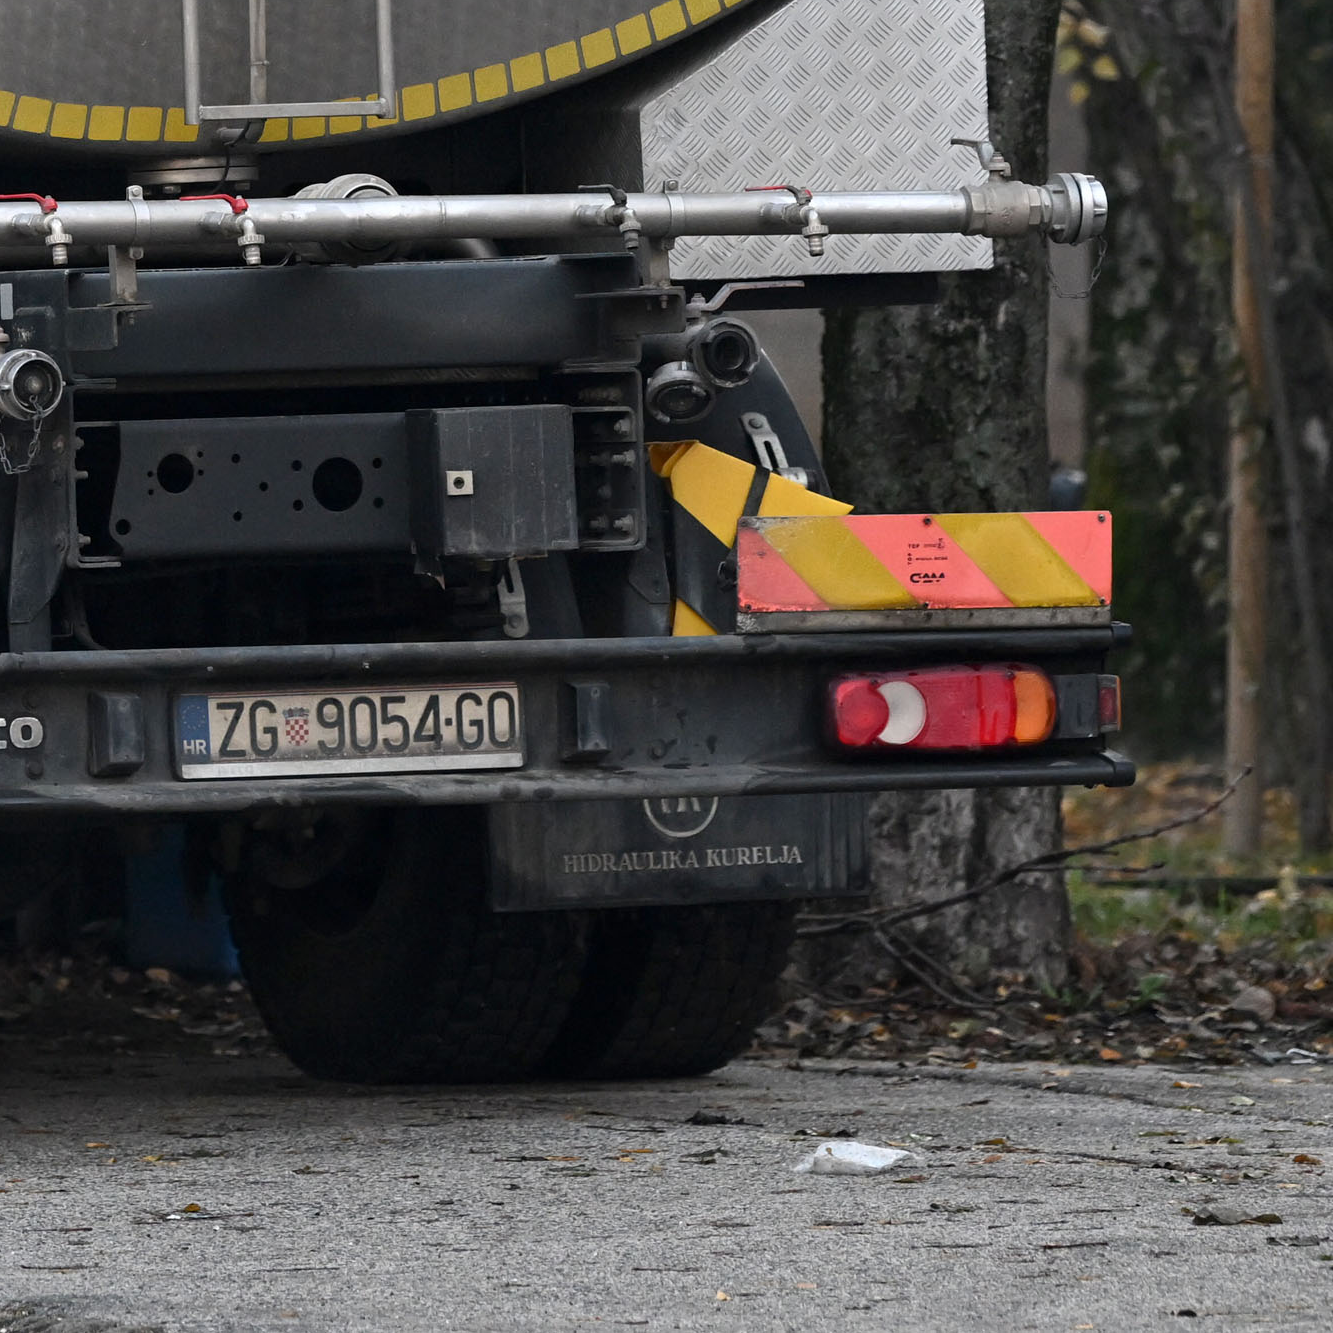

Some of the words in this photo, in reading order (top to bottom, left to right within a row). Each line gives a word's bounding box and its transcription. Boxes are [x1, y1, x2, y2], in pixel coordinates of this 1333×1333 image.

[183, 739, 207, 756] HR
[216, 698, 279, 759] ZG
[563, 848, 699, 874] HIDRAULIKA
[706, 844, 804, 868] KURELJA
